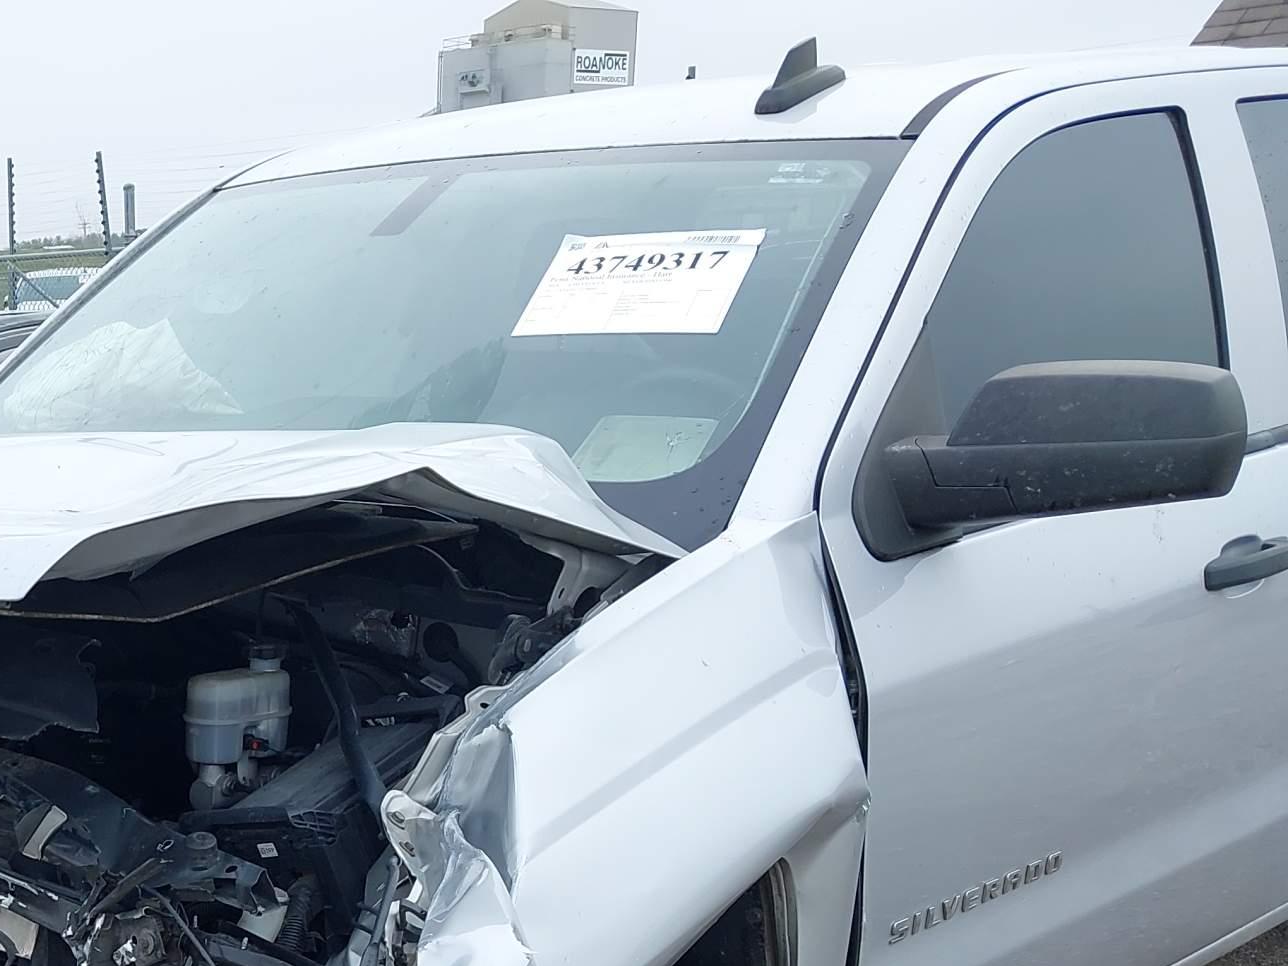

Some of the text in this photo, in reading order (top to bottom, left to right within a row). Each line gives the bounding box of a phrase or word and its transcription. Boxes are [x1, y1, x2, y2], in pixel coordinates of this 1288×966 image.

[576, 54, 627, 71] ROANOKE
[567, 250, 730, 275] 43749317
[888, 850, 1063, 945] SILVERADO
